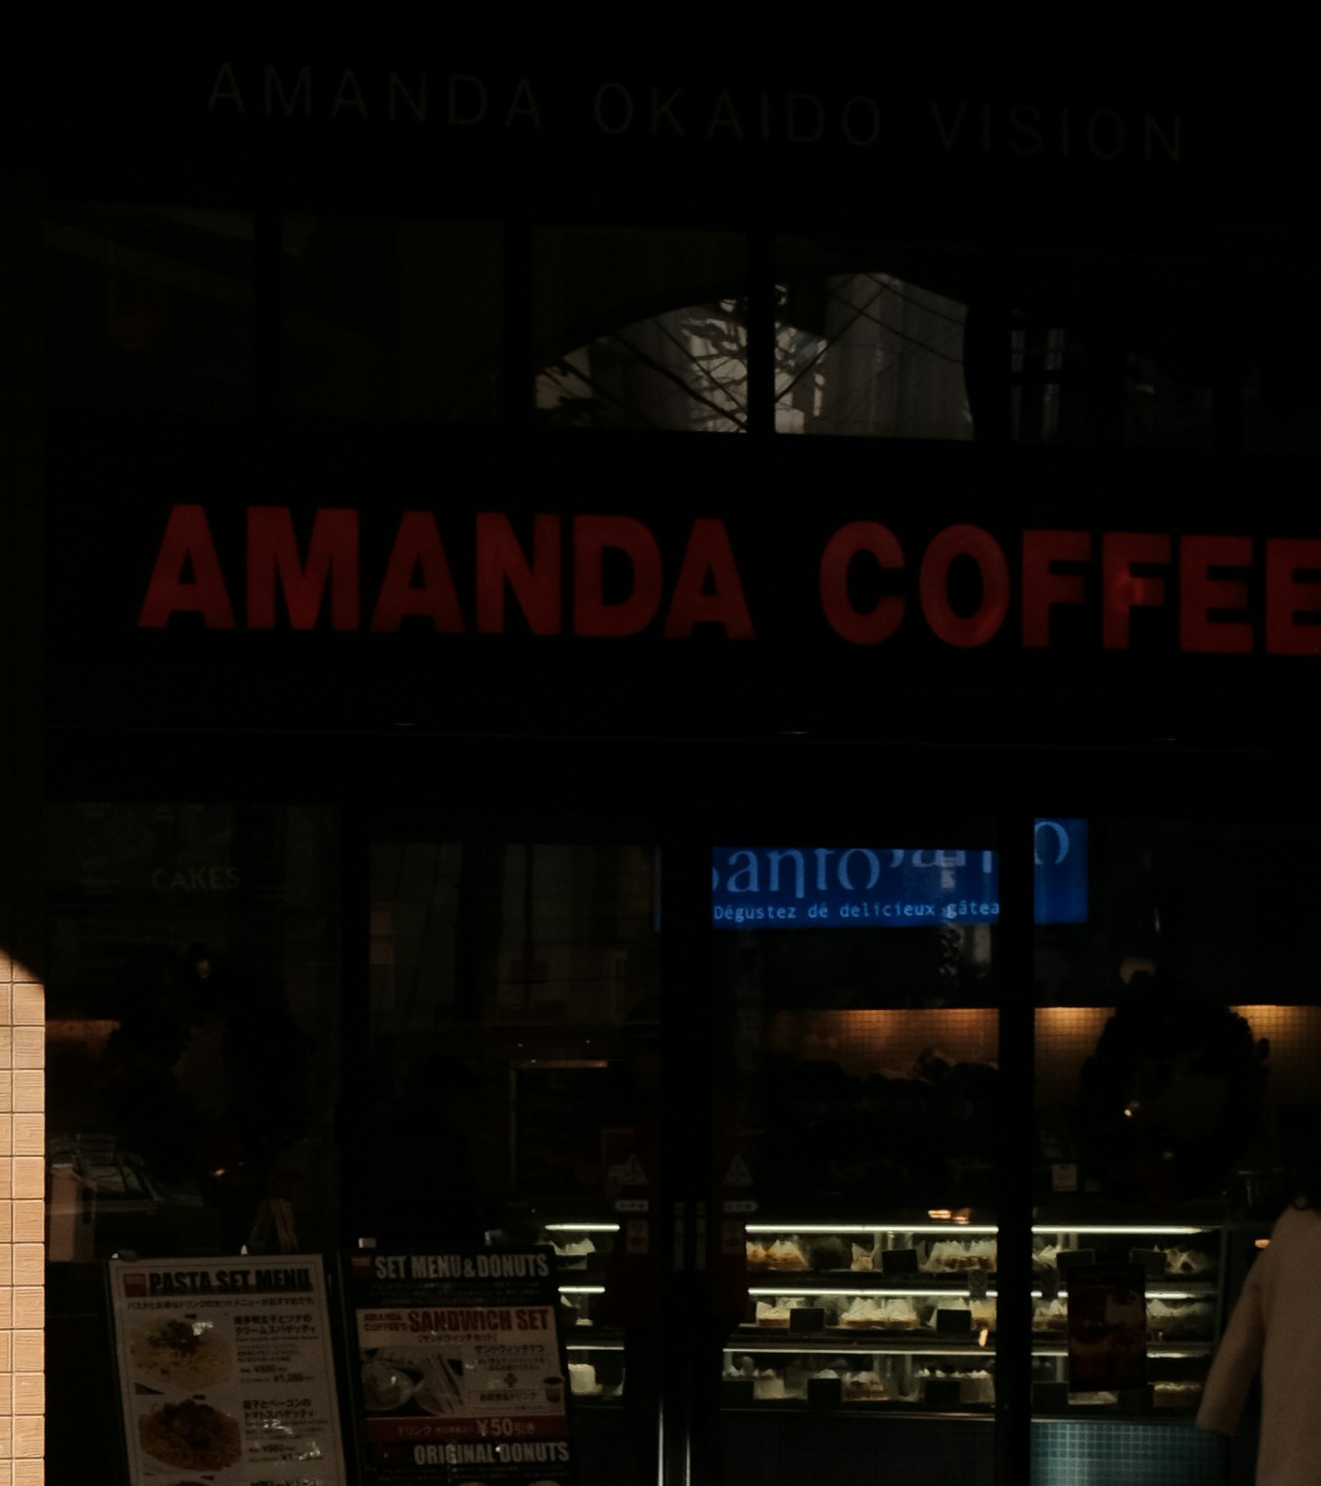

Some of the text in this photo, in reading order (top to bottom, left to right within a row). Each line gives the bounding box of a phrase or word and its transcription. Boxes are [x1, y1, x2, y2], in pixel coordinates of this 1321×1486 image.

[205, 61, 1183, 164] AMANDA OKAIDO VISION
[137, 502, 1321, 657] AMANDA COFFEE
[374, 1255, 407, 1280] SET
[149, 1268, 314, 1296] PASTA SET MENU
[409, 1309, 513, 1333] SANDWICH
[516, 1308, 549, 1331] SET
[414, 1440, 570, 1465] ORIGINAL DONUTS
